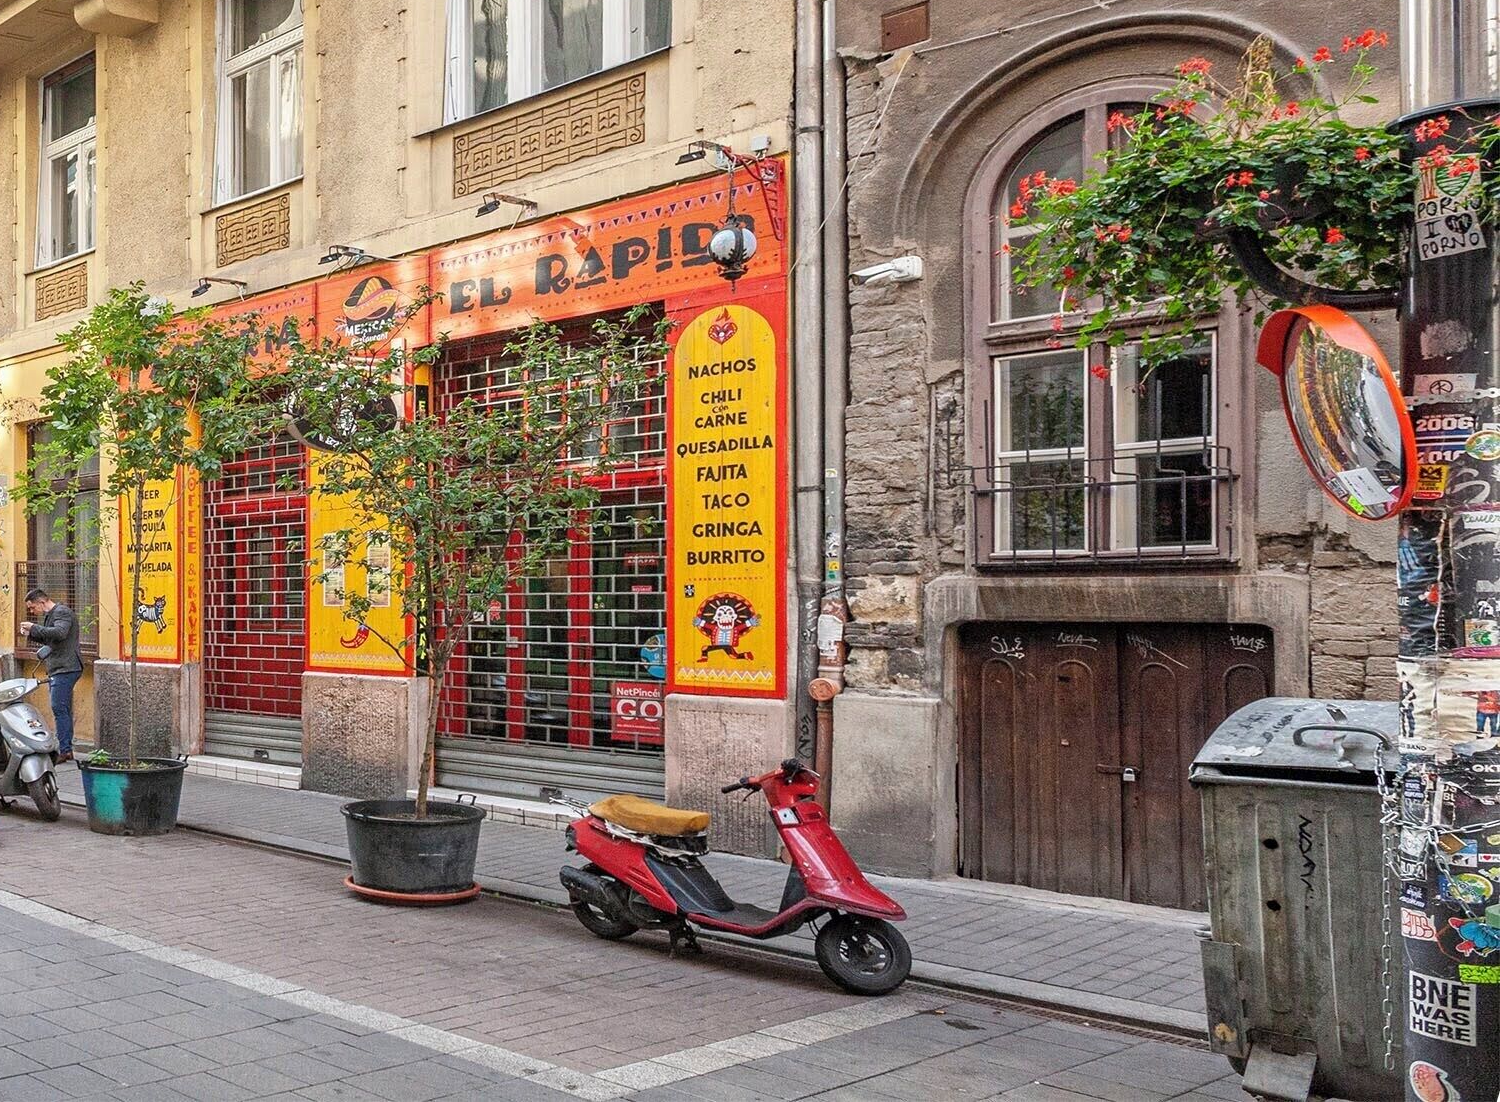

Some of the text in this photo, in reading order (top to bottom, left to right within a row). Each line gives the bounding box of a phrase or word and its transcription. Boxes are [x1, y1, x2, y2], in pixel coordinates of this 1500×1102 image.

[1418, 197, 1481, 219] PORNO
[1422, 233, 1479, 258] PORNO
[450, 214, 756, 314] EL RAPID
[689, 359, 756, 379] NACHOS
[701, 389, 741, 404] CHILI
[695, 412, 747, 429] CARNE
[1416, 417, 1474, 431] 2006
[677, 435, 773, 458] QUESADILLA
[697, 464, 747, 482] FAJITA
[702, 493, 750, 509] TACO
[132, 522, 166, 533] TQUILA
[693, 521, 762, 537] GRINGA
[687, 550, 765, 565] BURRITO
[128, 562, 172, 573] MHELADA
[617, 700, 663, 721] GO
[1412, 975, 1470, 1011] BNE
[1412, 1000, 1470, 1026] WAS
[1412, 1016, 1470, 1043] HERE
